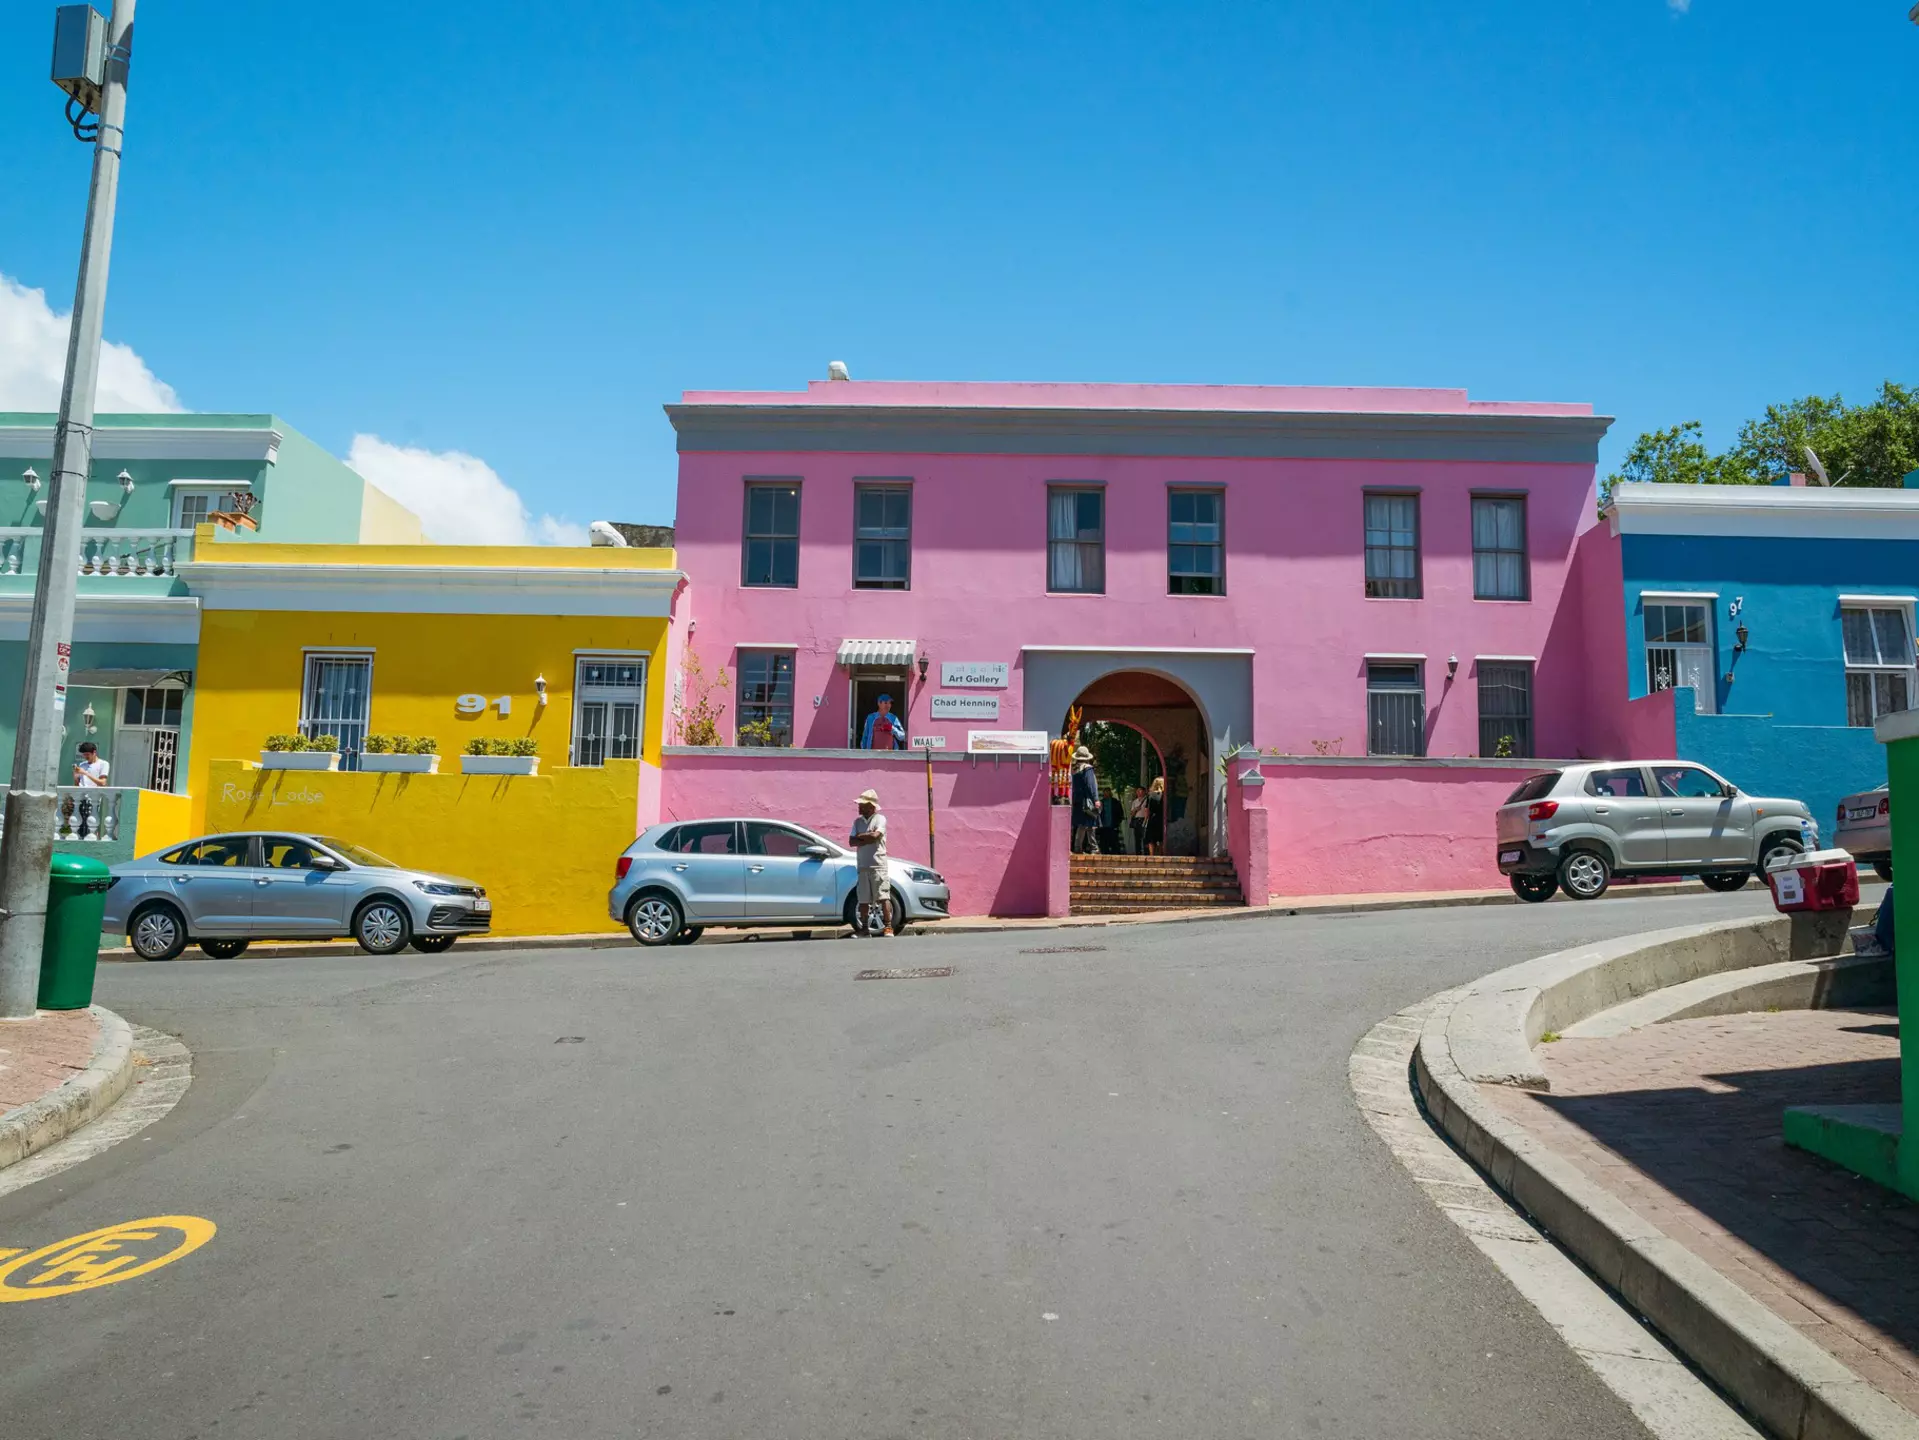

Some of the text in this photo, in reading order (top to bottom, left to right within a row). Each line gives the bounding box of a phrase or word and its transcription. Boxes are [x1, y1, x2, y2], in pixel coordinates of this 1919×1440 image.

[1730, 596, 1743, 616] 97
[949, 675, 999, 685] Art Gallery
[457, 694, 511, 714] 91
[934, 699, 997, 709] Chad Henning
[913, 738, 934, 747] WAAL
[221, 783, 324, 806] Rose Lodge
